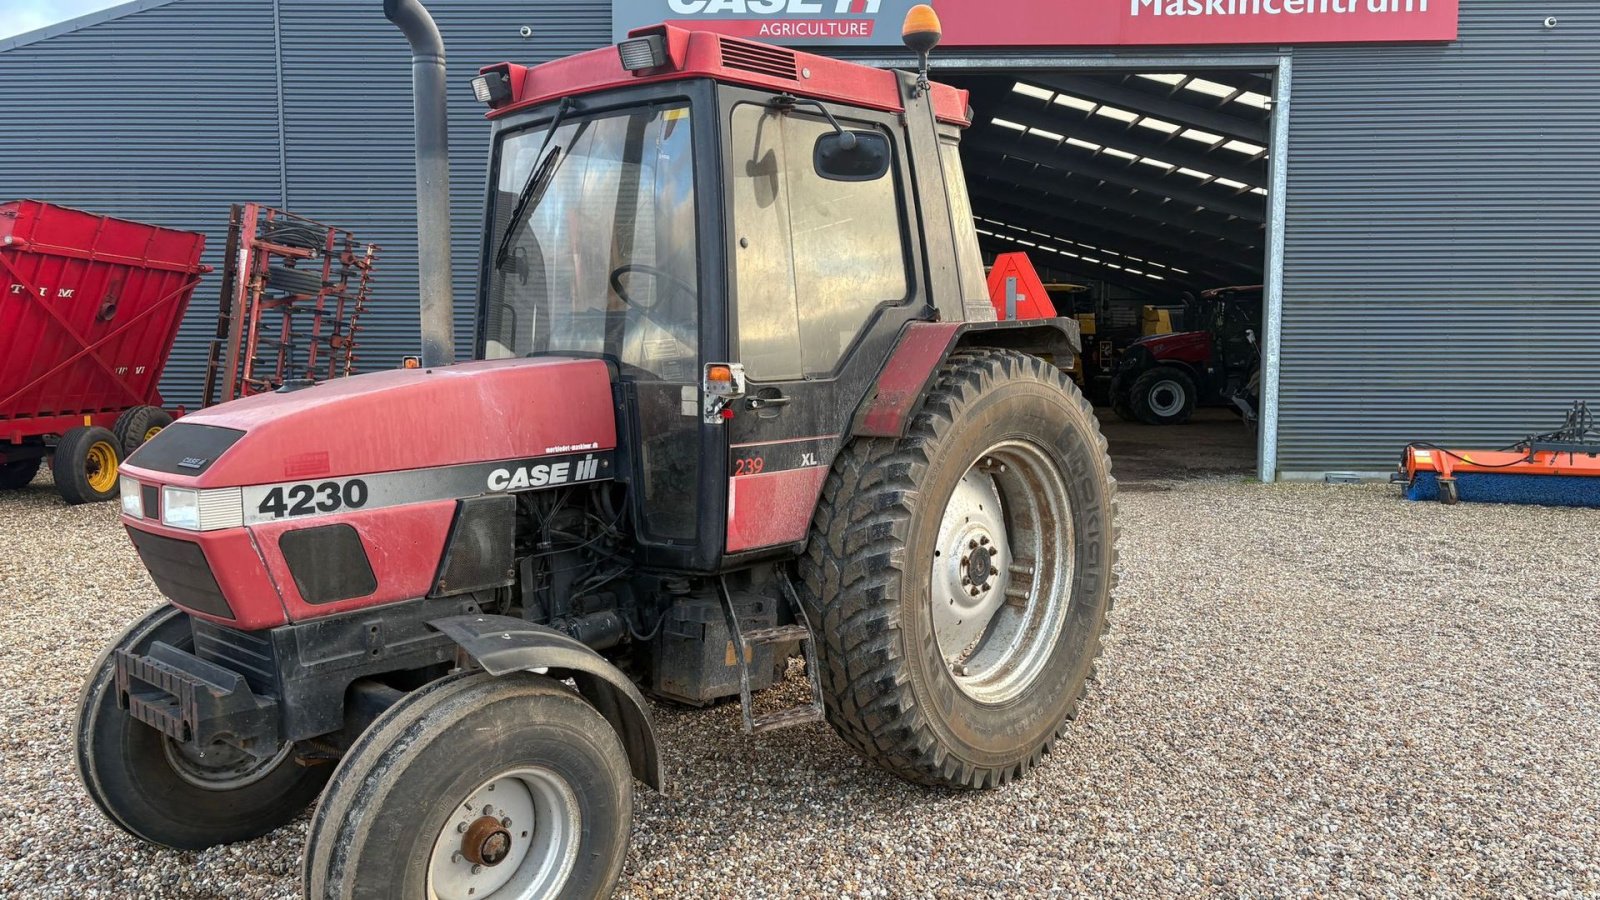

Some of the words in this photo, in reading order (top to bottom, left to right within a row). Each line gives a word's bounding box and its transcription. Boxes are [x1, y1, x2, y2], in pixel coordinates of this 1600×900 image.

[1130, 0, 1428, 16] Maskincentrum
[759, 22, 868, 36] AGRICULTURE
[487, 462, 570, 491] CASE
[735, 457, 764, 477] 239
[801, 453, 818, 467] XL
[259, 478, 368, 518] 4230
